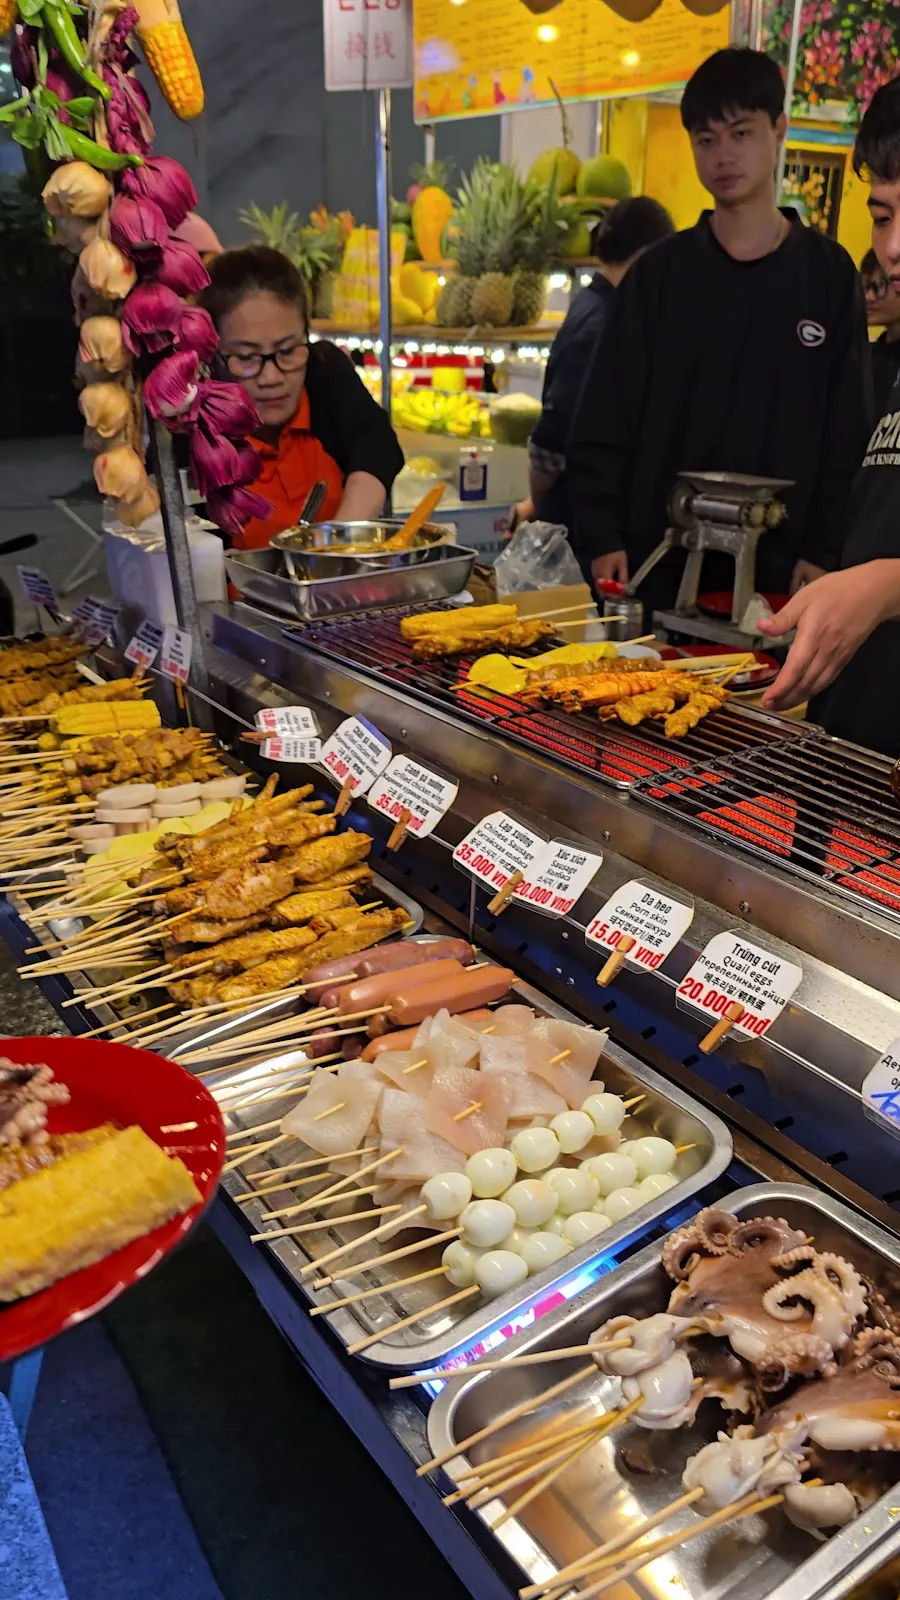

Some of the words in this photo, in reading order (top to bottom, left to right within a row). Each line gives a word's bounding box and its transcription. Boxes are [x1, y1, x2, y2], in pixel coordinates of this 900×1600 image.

[392, 769, 412, 784] Grilled
[411, 781, 432, 796] chicken
[376, 794, 404, 818] 35.00
[484, 822, 509, 842] Chinese
[508, 840, 534, 860] Sausage
[456, 843, 496, 876] 35.000
[491, 870, 508, 887] vn
[551, 860, 578, 874] Sausage
[513, 880, 553, 904] 20.000
[641, 892, 654, 906] Da
[654, 899, 672, 914] heo
[615, 906, 645, 925] Свиная
[644, 922, 672, 938] шкура
[630, 902, 650, 916] Porn
[650, 912, 668, 926] skin
[634, 946, 665, 968] vnđ
[698, 955, 761, 993] Перепелиные
[761, 990, 786, 1006] яйца
[723, 956, 750, 974] Quail
[750, 970, 773, 986] eggs
